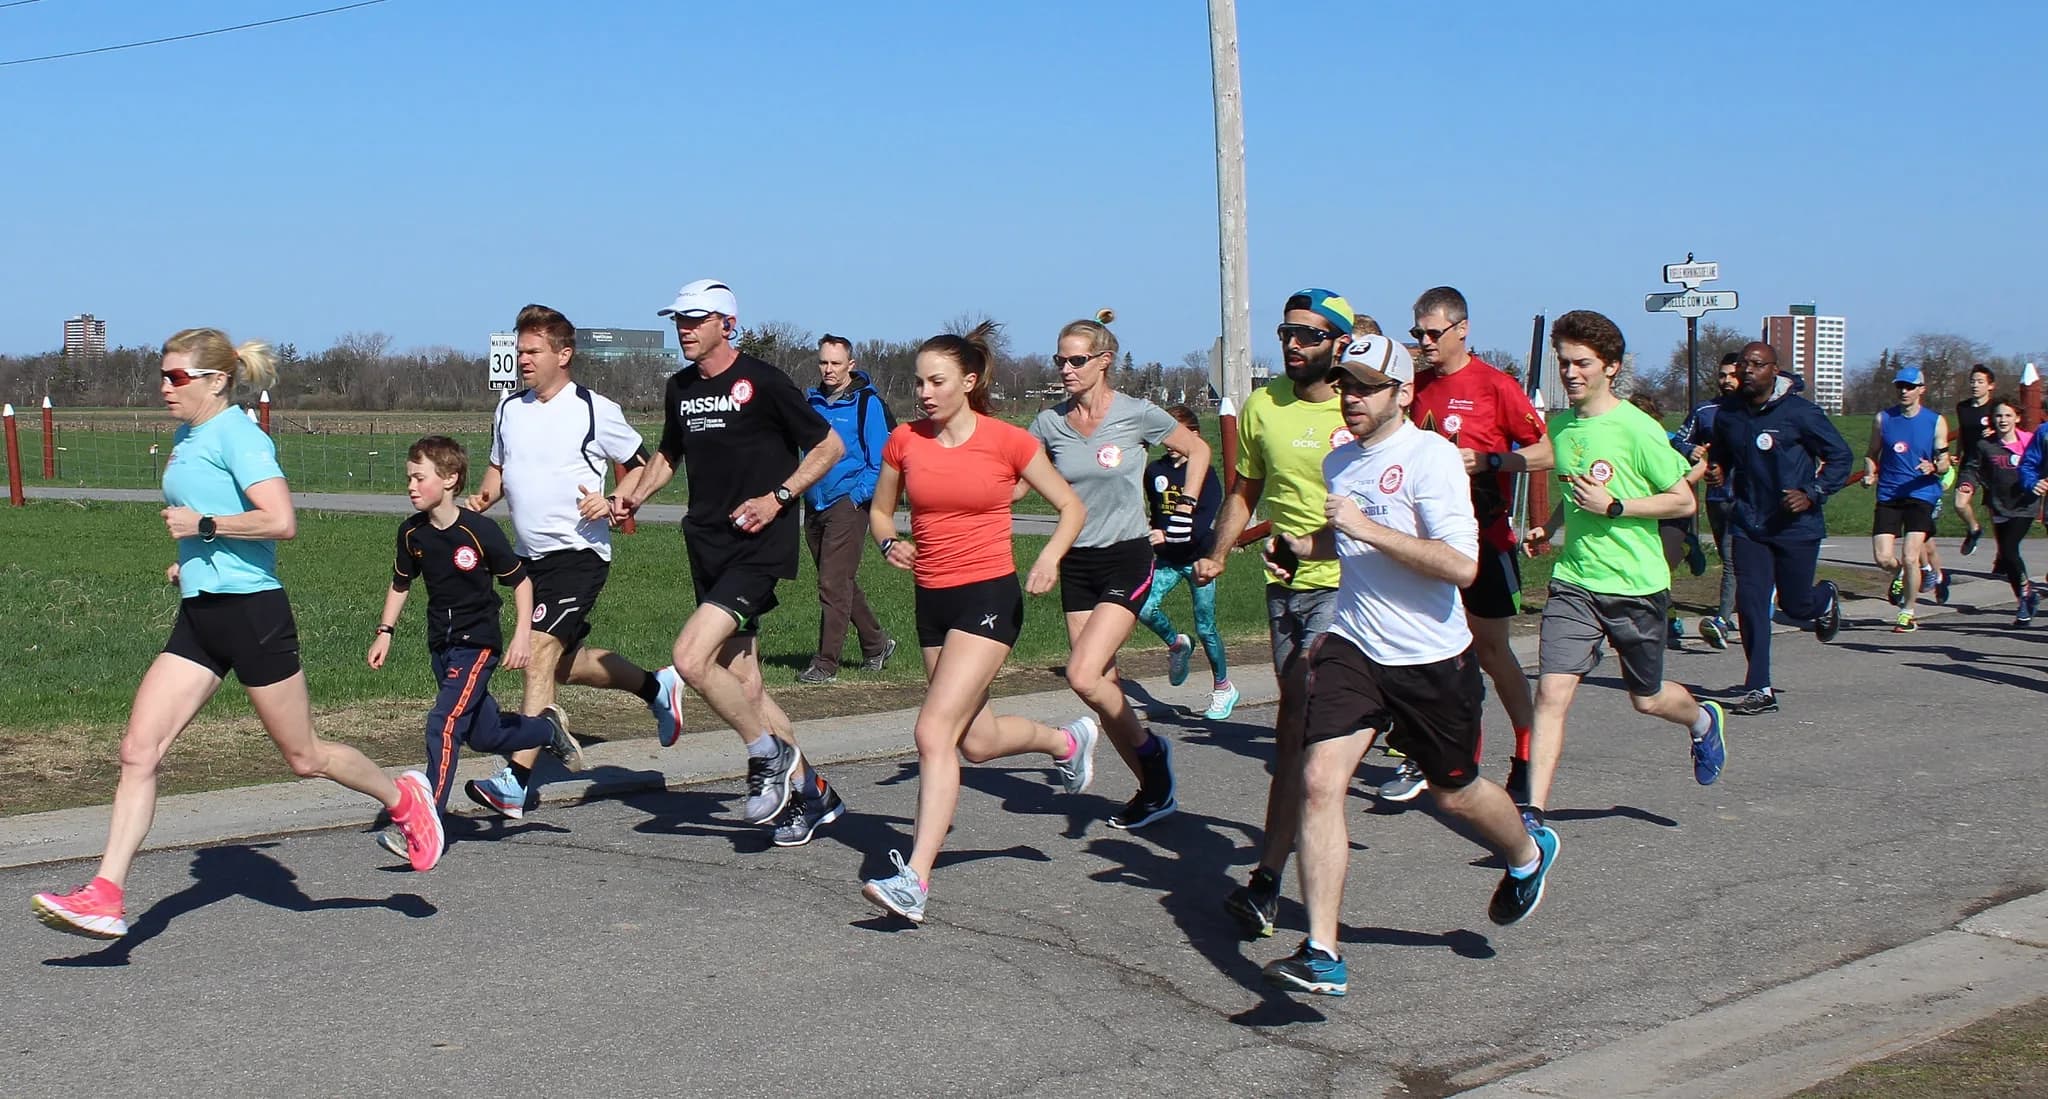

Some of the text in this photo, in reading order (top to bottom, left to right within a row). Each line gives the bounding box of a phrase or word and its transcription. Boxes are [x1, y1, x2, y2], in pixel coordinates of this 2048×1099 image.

[1687, 296, 1700, 307] COW
[1702, 296, 1718, 307] LANE
[492, 353, 514, 374] 30
[492, 381, 513, 389] km/h
[1292, 439, 1321, 448] OCRC
